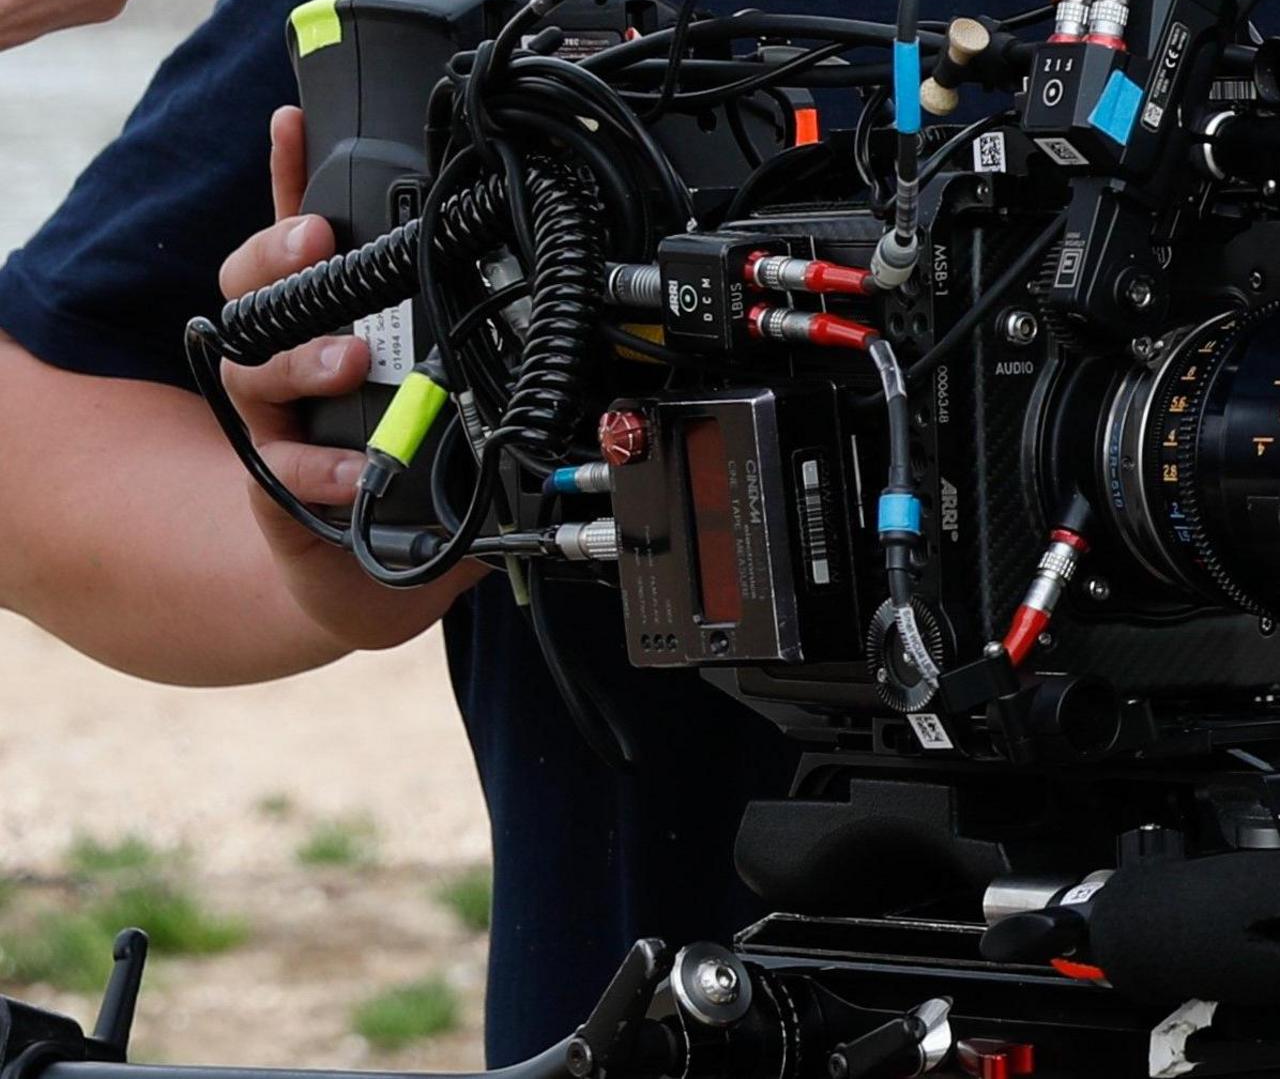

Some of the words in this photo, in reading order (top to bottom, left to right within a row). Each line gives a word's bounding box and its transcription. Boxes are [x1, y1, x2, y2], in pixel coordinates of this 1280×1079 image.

[933, 244, 949, 296] MSB-1
[668, 280, 681, 317] ARRI
[730, 282, 744, 320] LBUS
[936, 365, 950, 423] 0006348
[995, 361, 1034, 375] AUDIO
[731, 498, 742, 531] TAPE
[744, 459, 761, 525] CINEMA
[940, 477, 958, 531] ARRI
[736, 537, 748, 600] MEASURE
